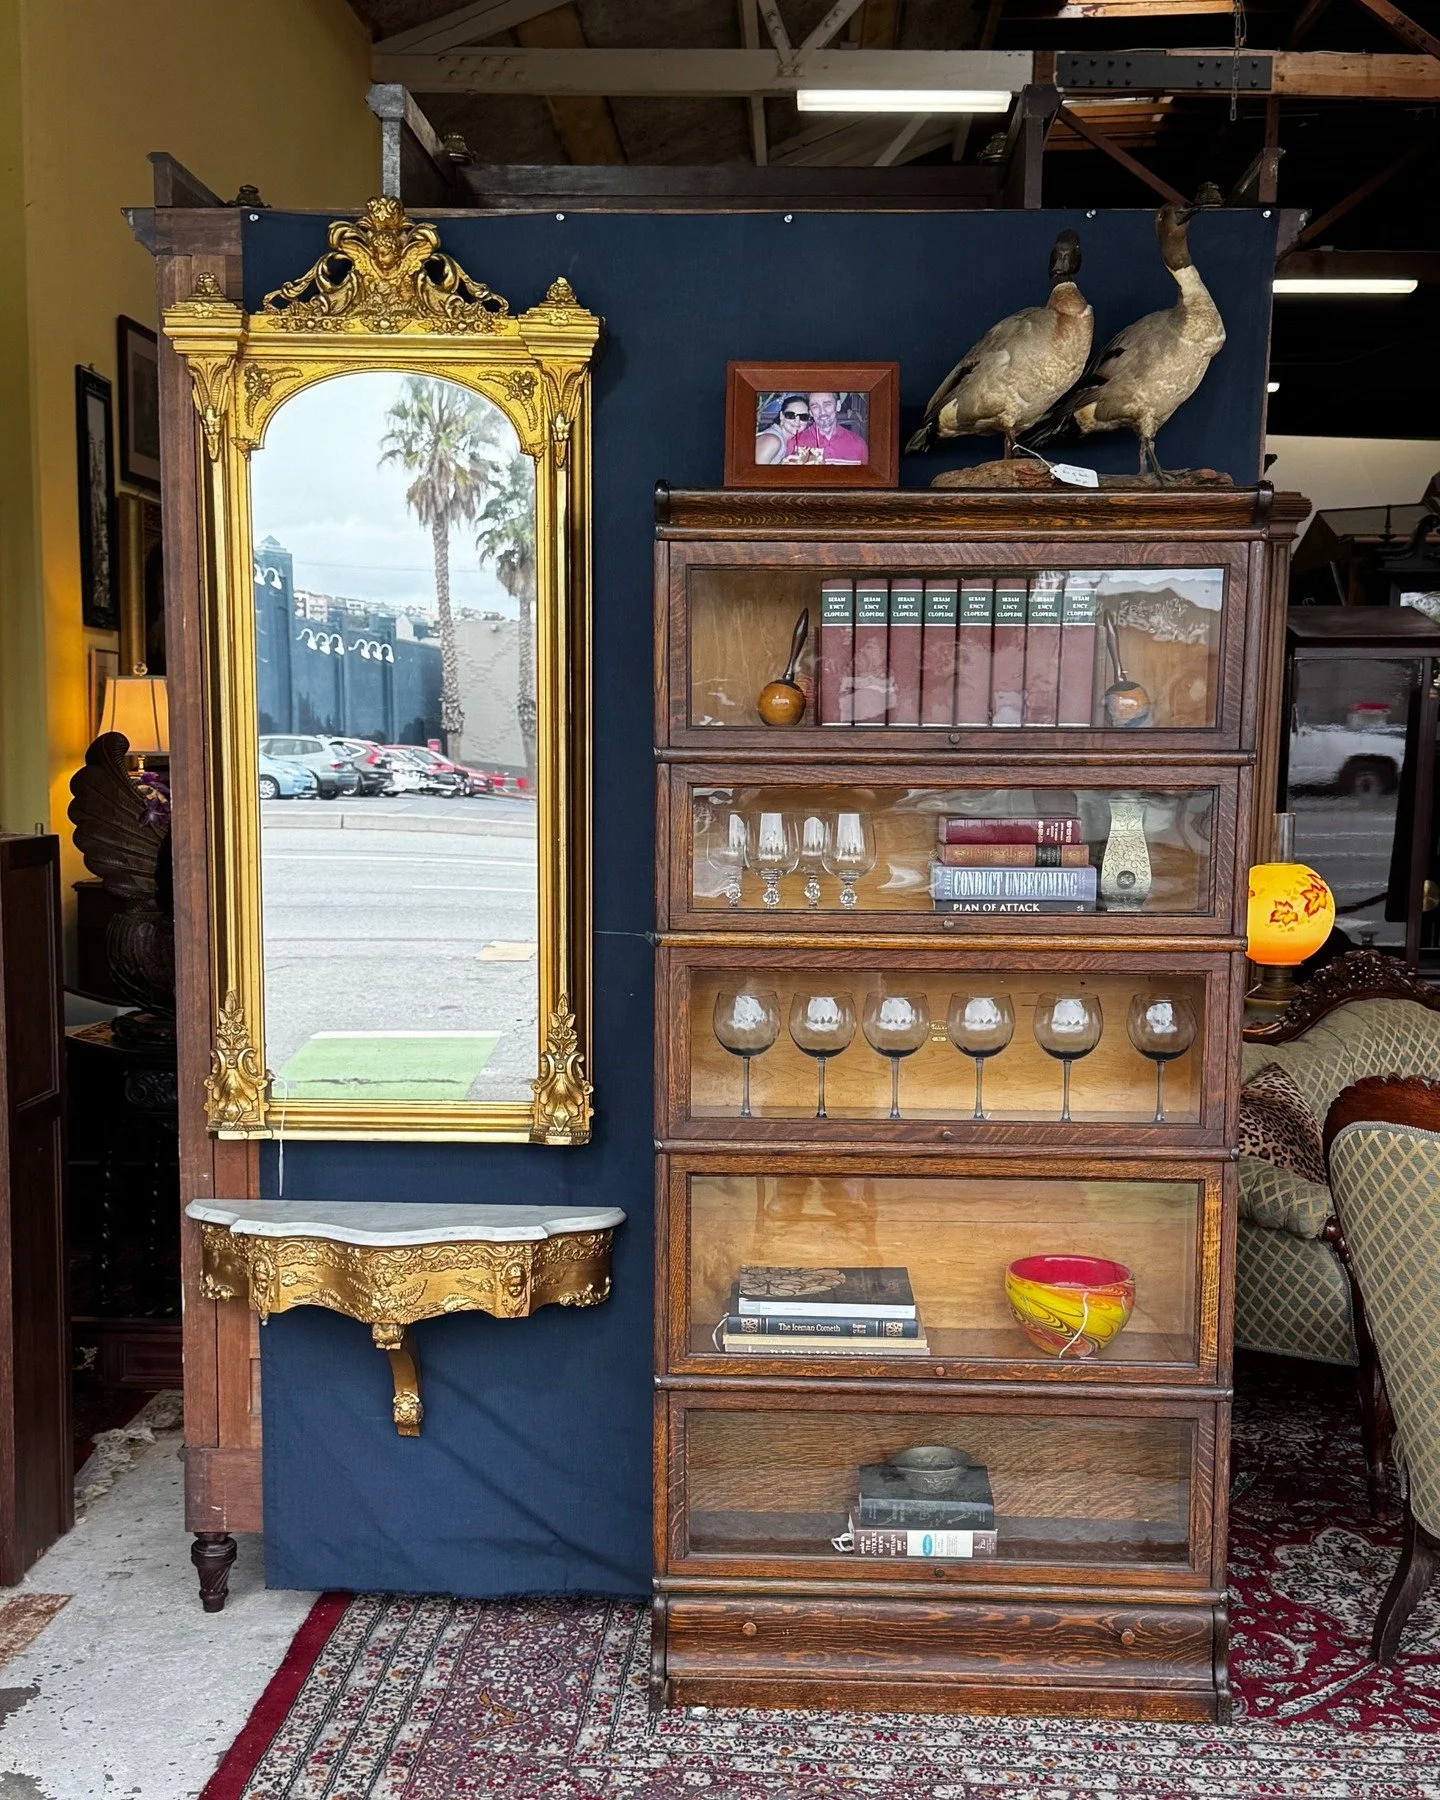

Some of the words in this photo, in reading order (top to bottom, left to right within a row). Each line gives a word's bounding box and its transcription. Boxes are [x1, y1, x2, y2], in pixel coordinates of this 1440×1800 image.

[954, 870, 1002, 896] CONDUCT
[1005, 872, 1078, 897] UNBECOMING
[953, 903, 979, 912] PLAN
[982, 903, 996, 912] OF
[1000, 903, 1040, 912] ATTACK
[779, 1323, 791, 1331] The
[792, 1323, 815, 1332] Iceman
[816, 1324, 840, 1332] Cometh
